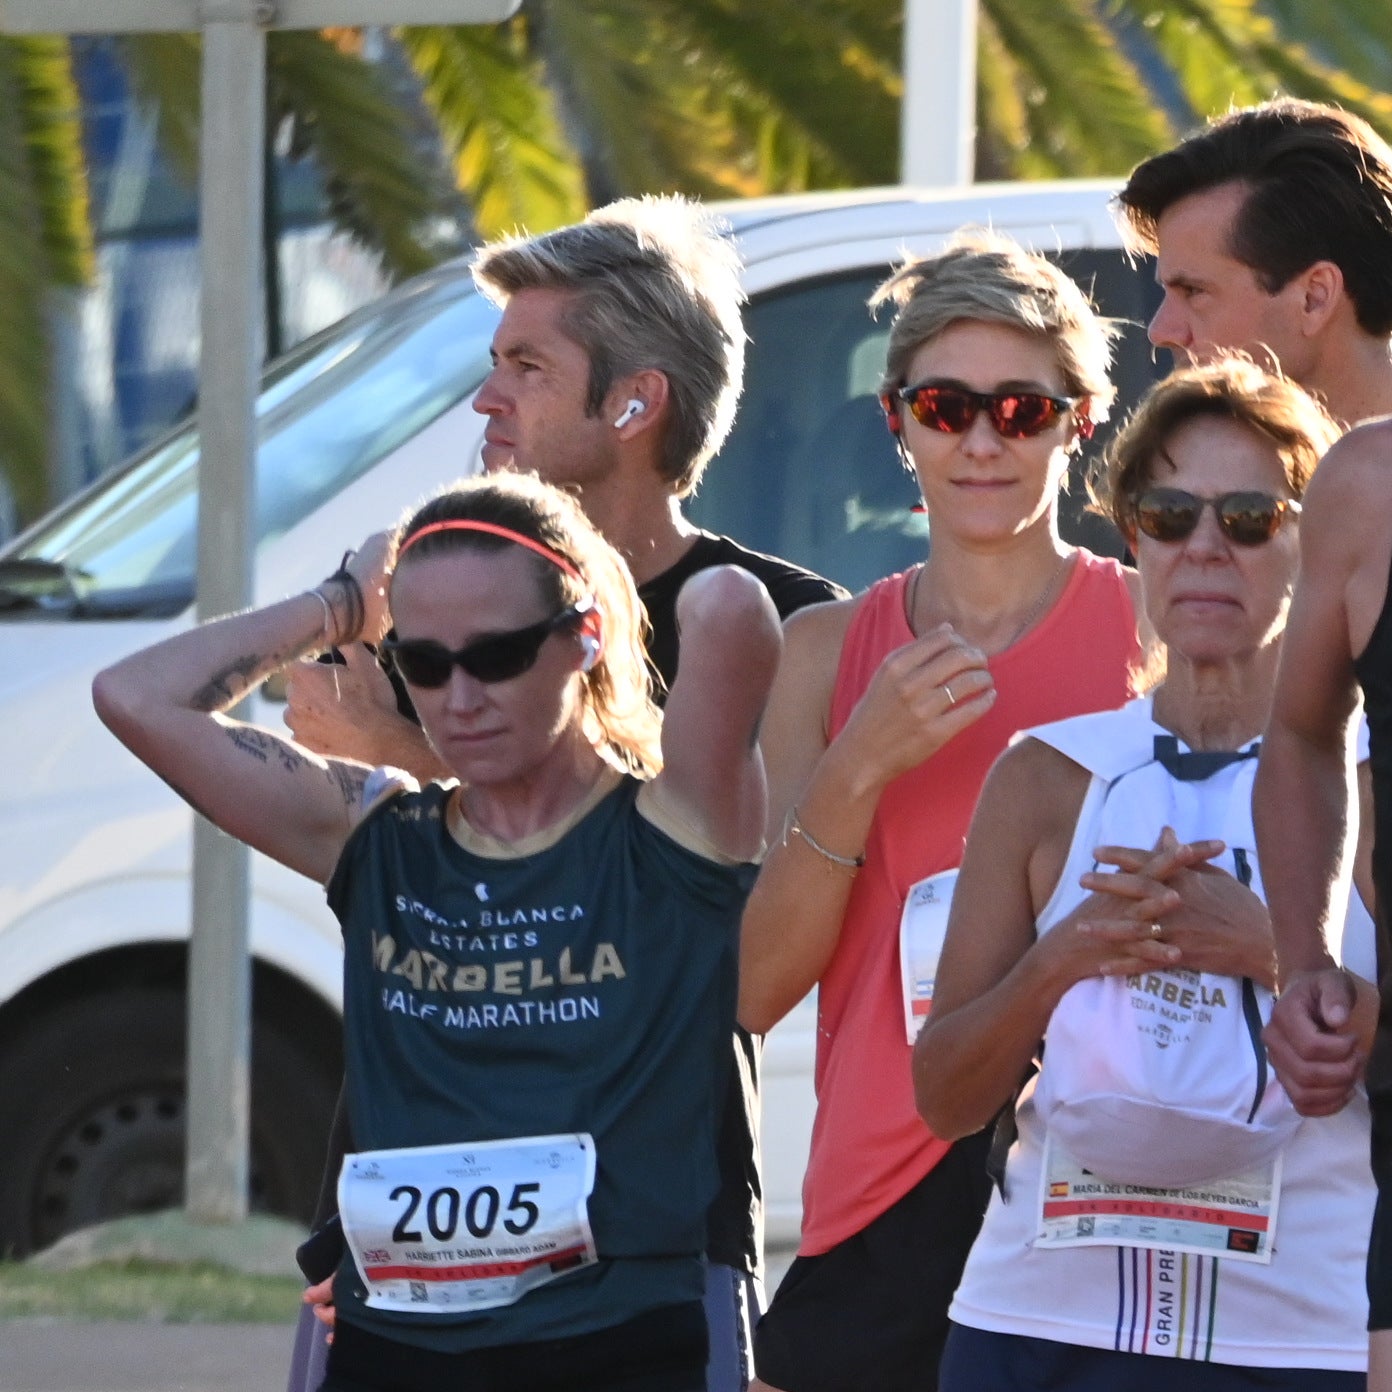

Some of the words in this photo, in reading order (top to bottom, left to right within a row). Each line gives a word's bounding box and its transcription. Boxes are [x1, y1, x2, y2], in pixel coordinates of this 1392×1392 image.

[480, 904, 585, 928] BLANCA
[429, 930, 539, 951] ESTATES
[444, 996, 601, 1029] MARATHON
[1103, 1184, 1122, 1194] DEL
[388, 1182, 541, 1243] 2005
[1155, 1290, 1174, 1346] GRAN
